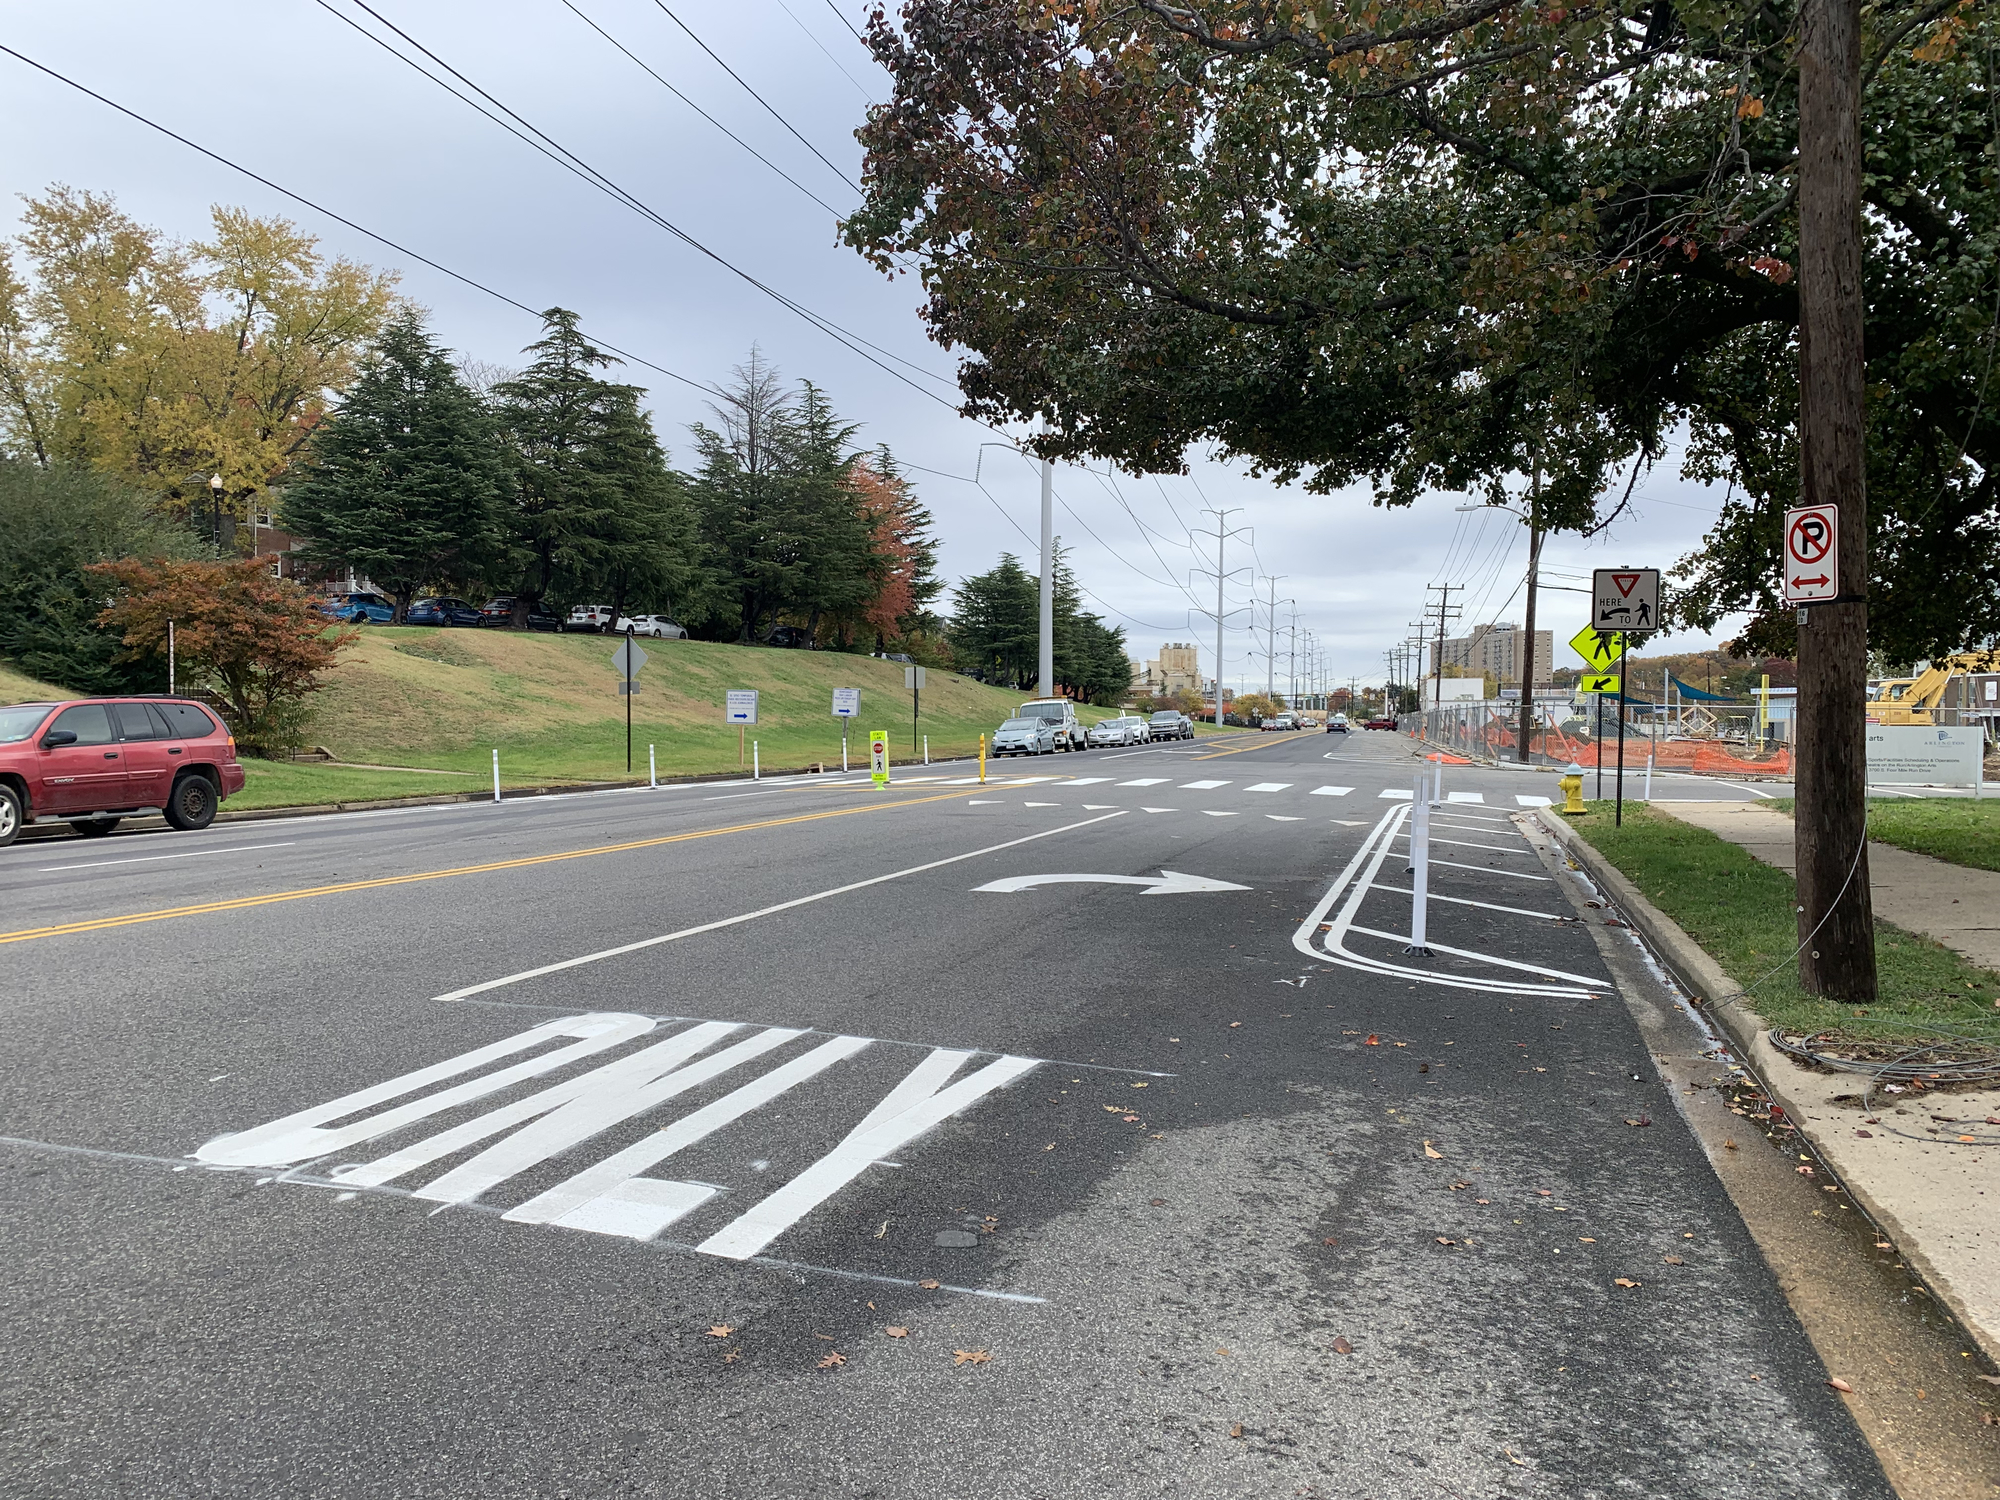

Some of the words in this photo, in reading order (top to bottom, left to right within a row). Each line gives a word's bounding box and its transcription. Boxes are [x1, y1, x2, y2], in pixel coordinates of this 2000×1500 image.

[1600, 598, 1622, 606] HERE
[1620, 616, 1631, 624] TO
[193, 1012, 1041, 1260] ONLY
